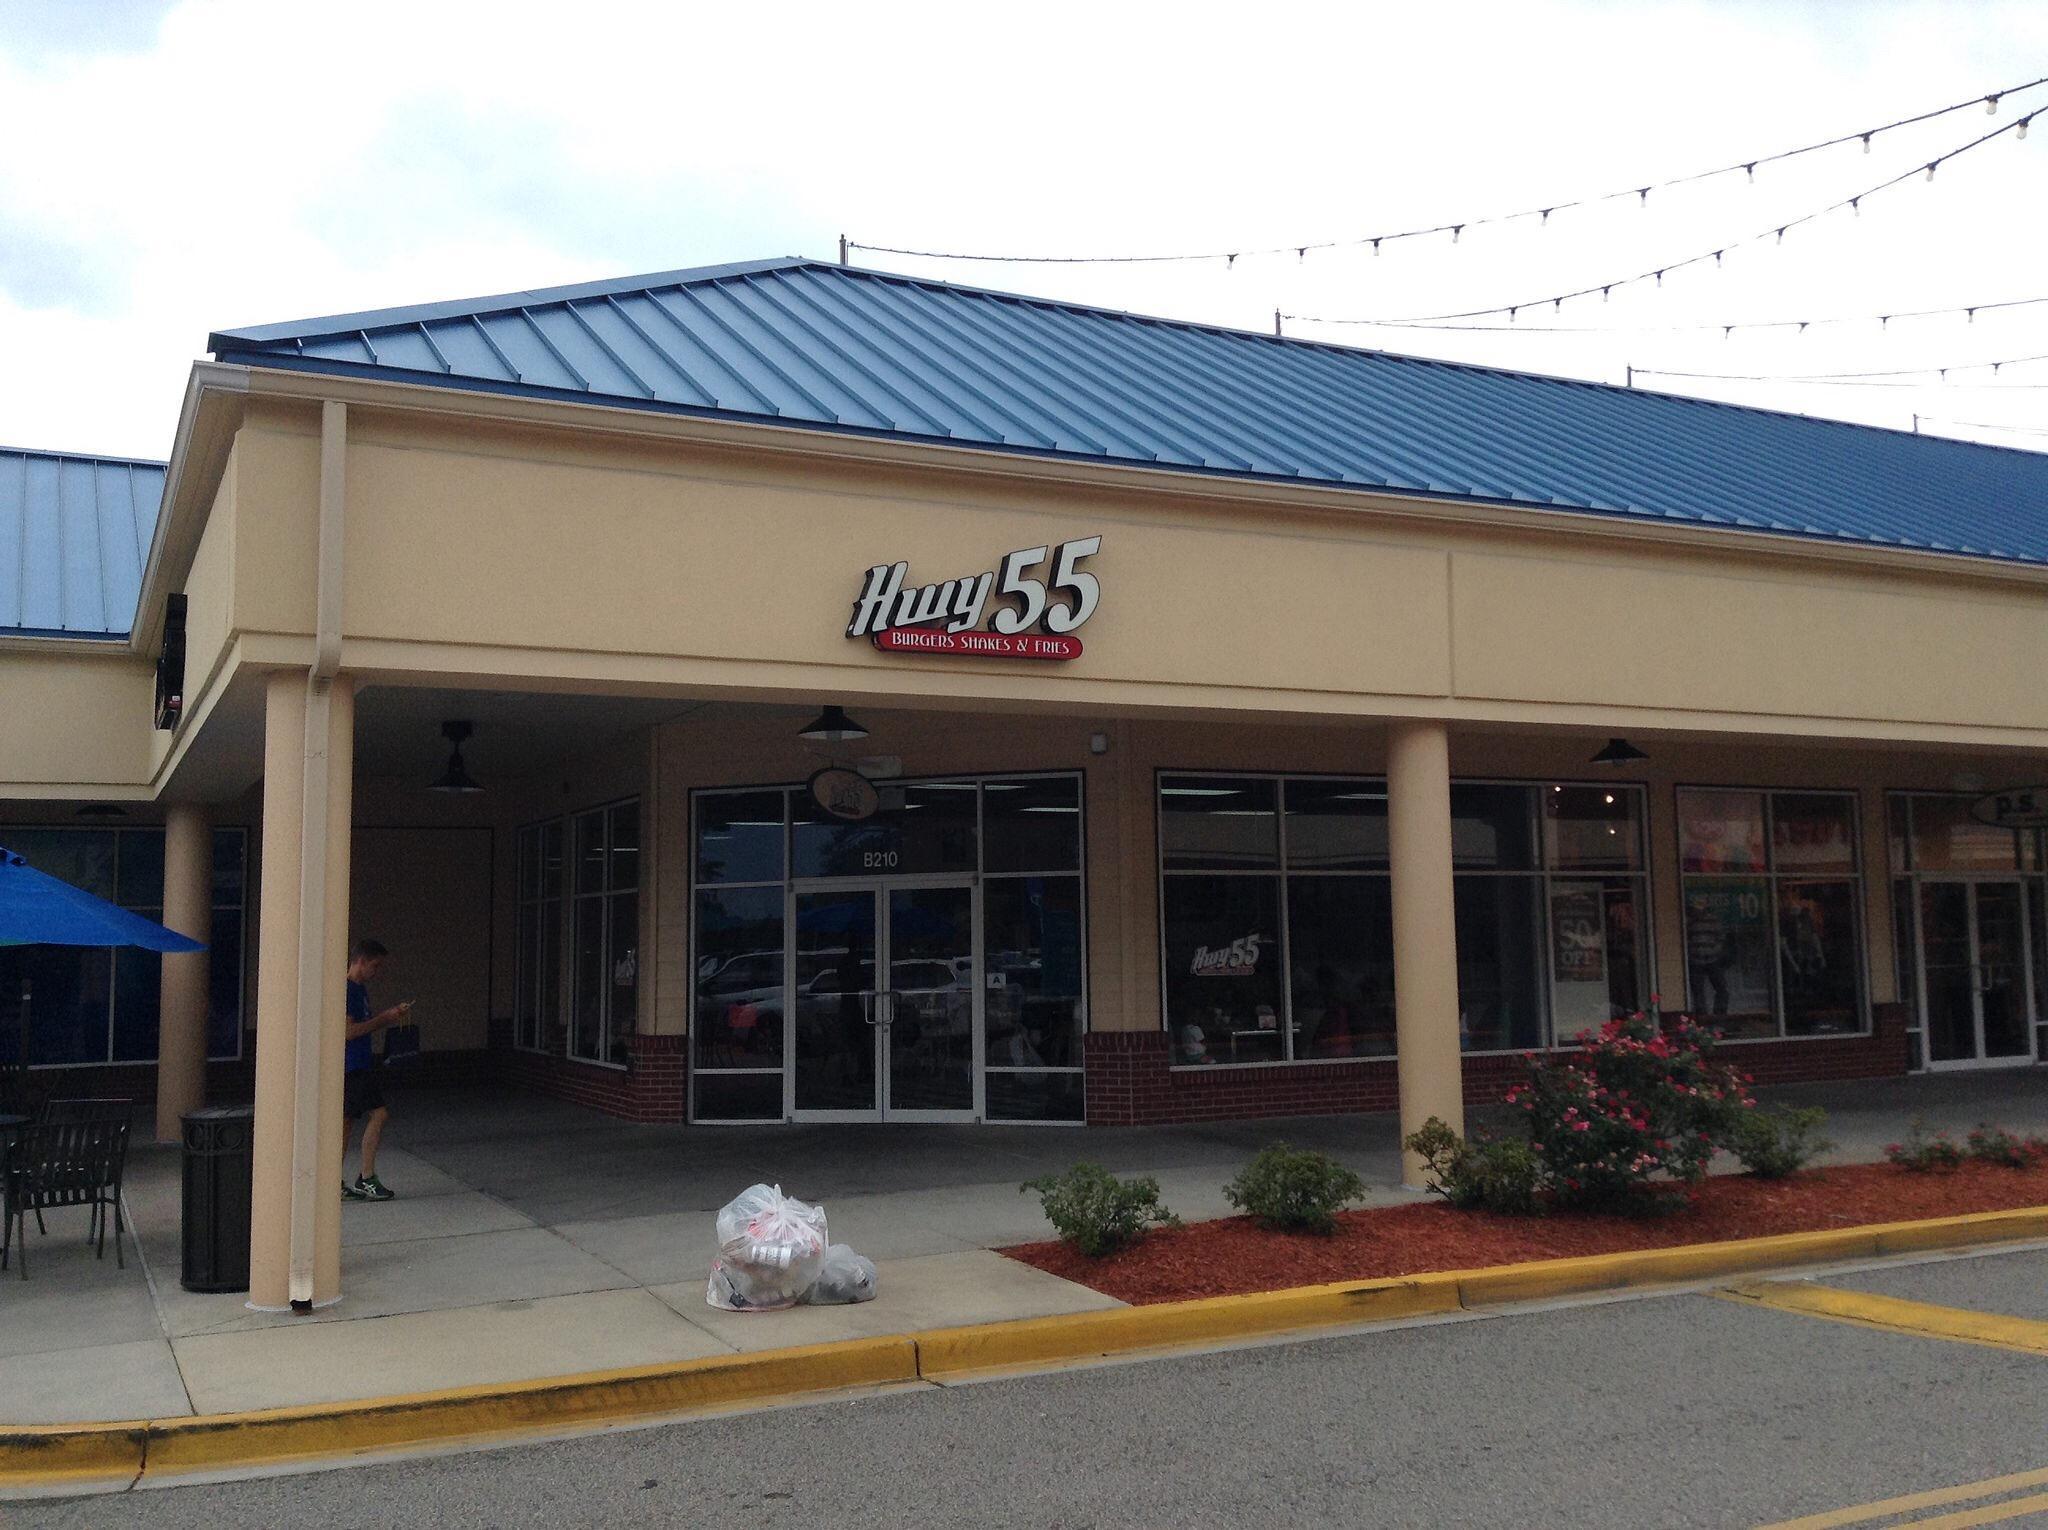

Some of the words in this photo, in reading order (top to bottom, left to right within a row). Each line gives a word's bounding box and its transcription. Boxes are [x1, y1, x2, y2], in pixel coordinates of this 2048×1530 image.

[846, 561, 994, 639] Hwy
[988, 535, 1102, 635] 55
[892, 631, 954, 648] BURGERS
[960, 634, 1011, 651] SHAKES
[1016, 638, 1029, 652] &
[1035, 640, 1070, 655] FRIES
[864, 851, 898, 867] B210
[1229, 933, 1260, 967] 55
[992, 976, 1001, 984] A
